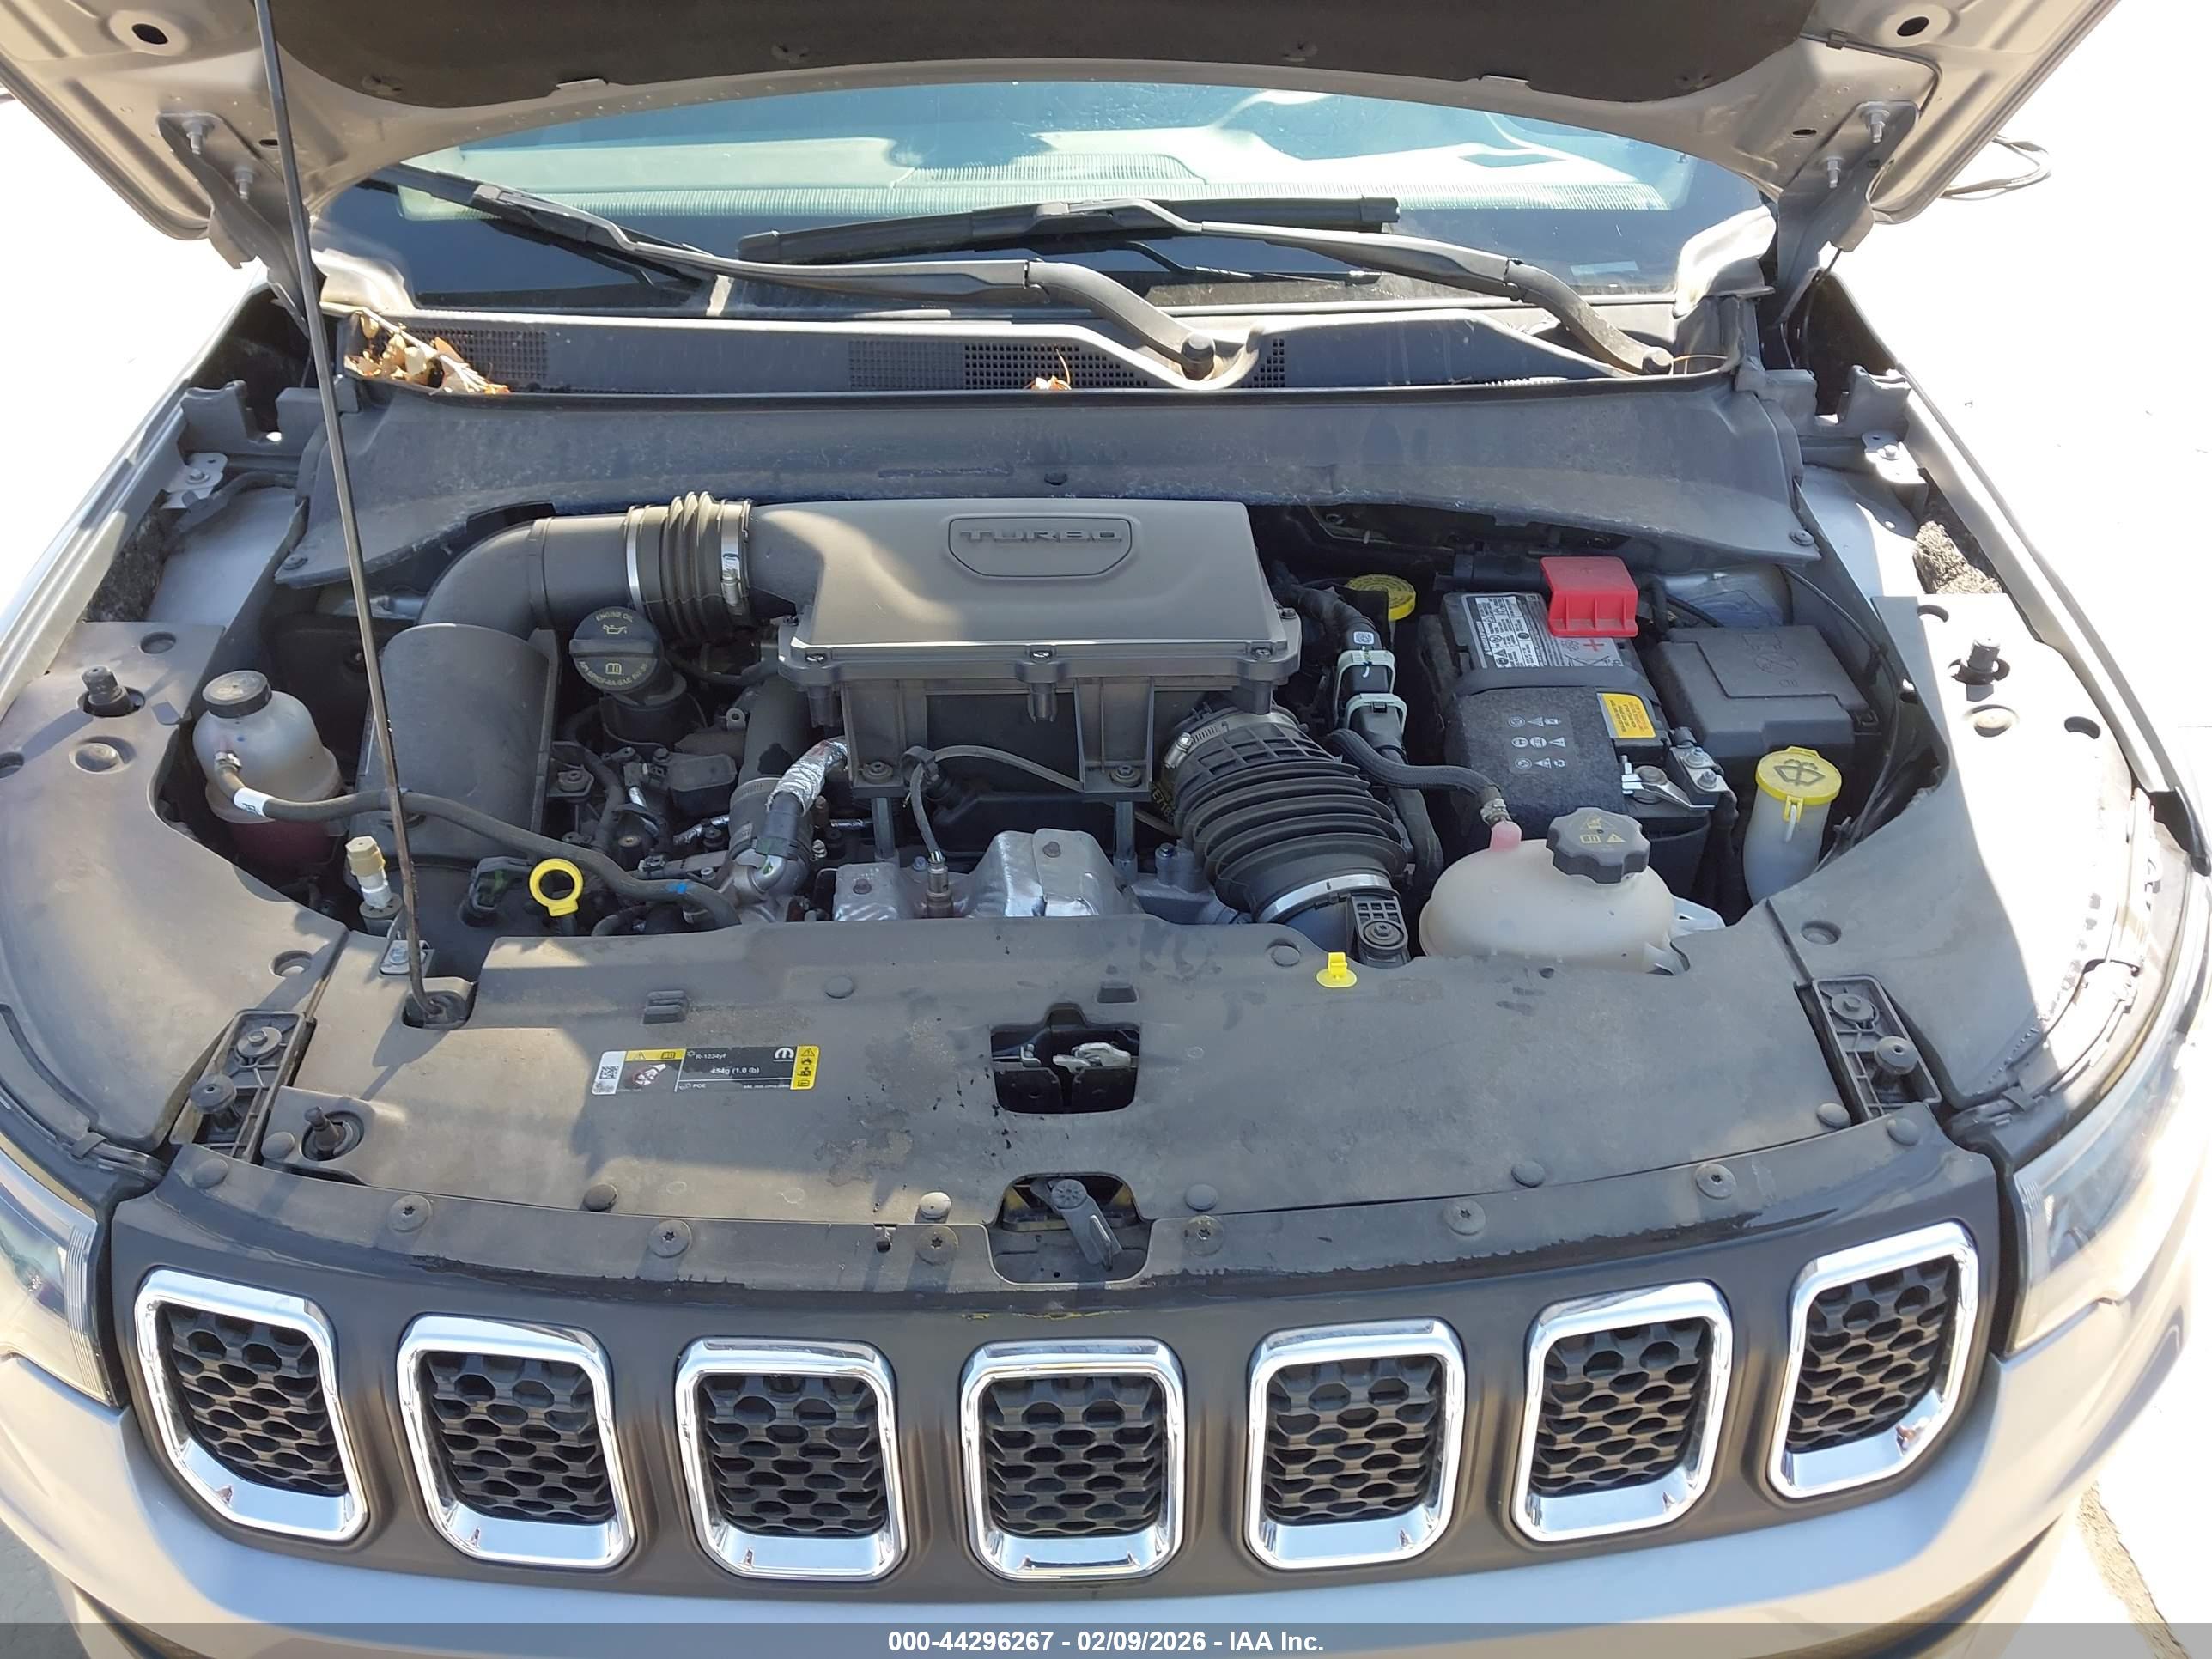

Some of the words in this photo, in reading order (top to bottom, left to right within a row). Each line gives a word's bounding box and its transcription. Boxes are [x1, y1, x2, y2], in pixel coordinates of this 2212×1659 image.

[960, 530, 1122, 544] TURBO
[595, 611, 622, 622] ENGINE
[623, 612, 634, 623] OIL
